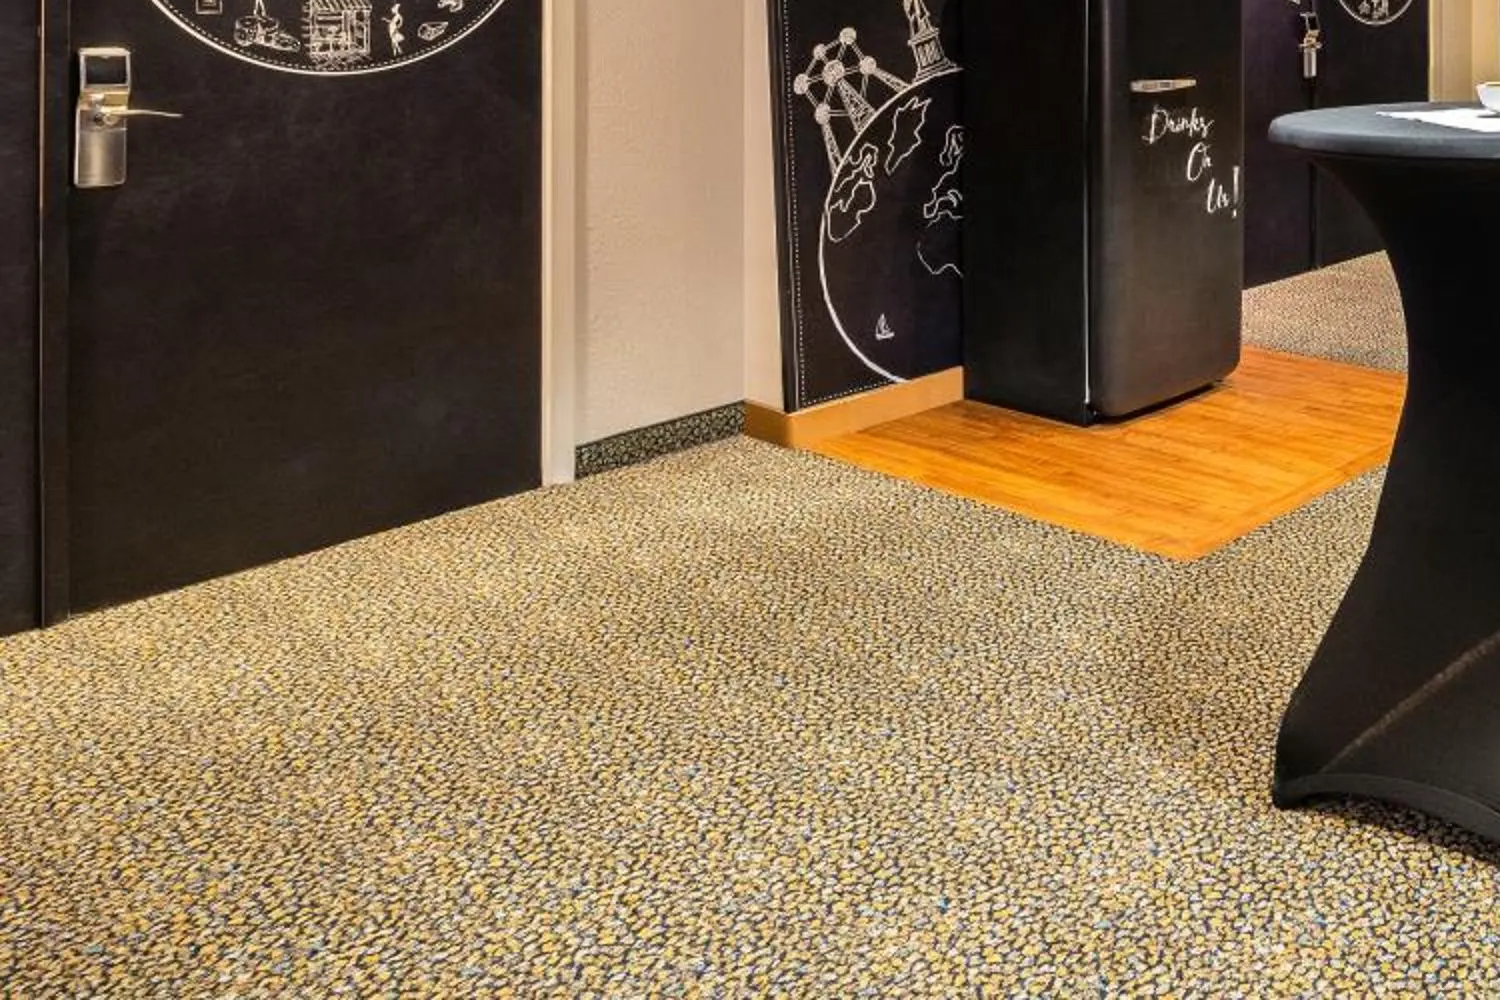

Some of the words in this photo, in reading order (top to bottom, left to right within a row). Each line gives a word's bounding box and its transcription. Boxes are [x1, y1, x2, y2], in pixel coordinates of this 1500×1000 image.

[1141, 104, 1215, 145] Drinks
[1187, 142, 1213, 182] On
[1207, 165, 1240, 219] Us!
